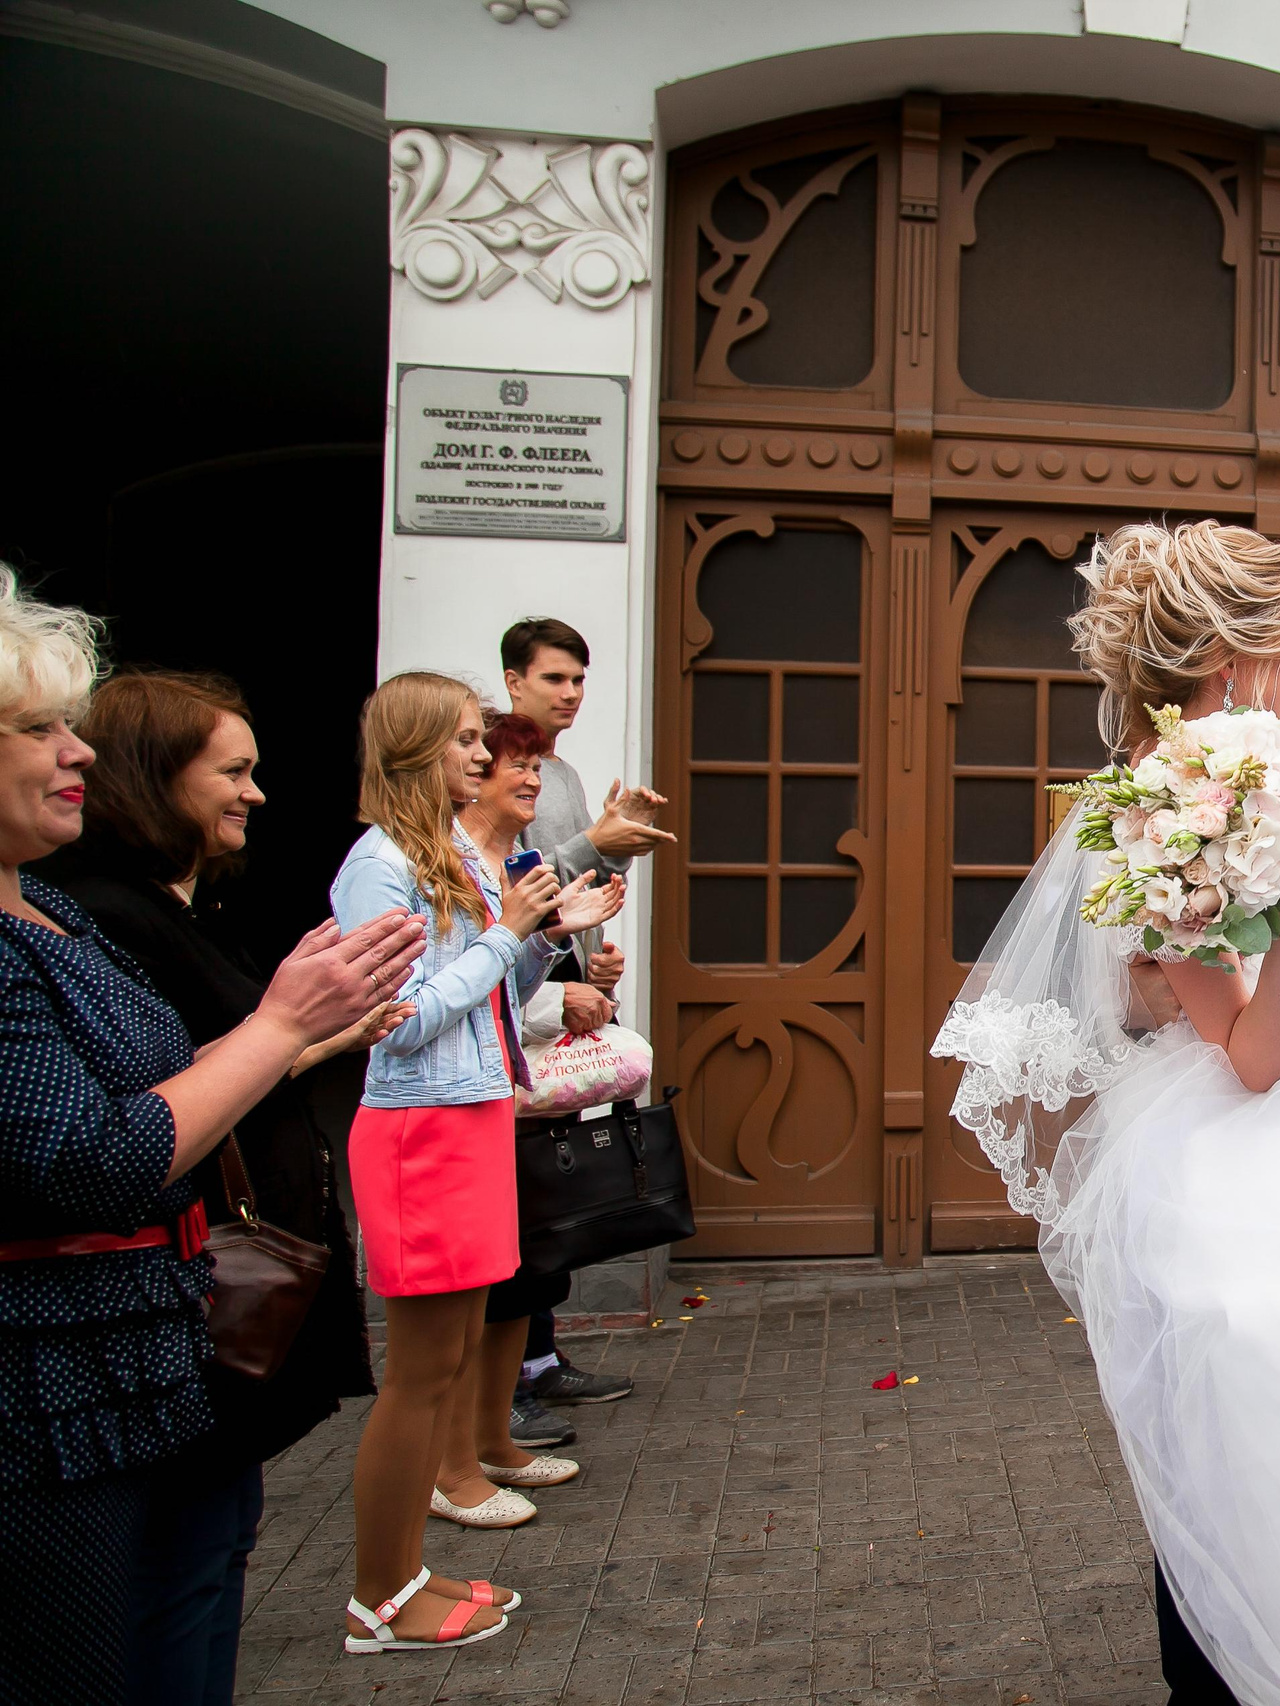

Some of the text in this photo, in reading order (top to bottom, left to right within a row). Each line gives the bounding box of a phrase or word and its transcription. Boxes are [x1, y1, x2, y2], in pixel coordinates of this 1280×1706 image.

[423, 408, 466, 419] ОБЪЕКТ
[545, 414, 602, 425] НАСЛЕДИЯ
[445, 421, 588, 436] ФЕДЕРАЛЬНОГО ЗНАЧЕНИЯ
[433, 442, 592, 462] ДОМ Г. Ф. ФЛЕЕРА
[465, 463, 545, 473] АПТЕКАРСКОГО
[415, 494, 606, 511] ПОДЛЕЖИТ ГОСУДАРСТВЕННОЙ ОХРАНЕ
[555, 1056, 622, 1076] ПОКУПКУ!
